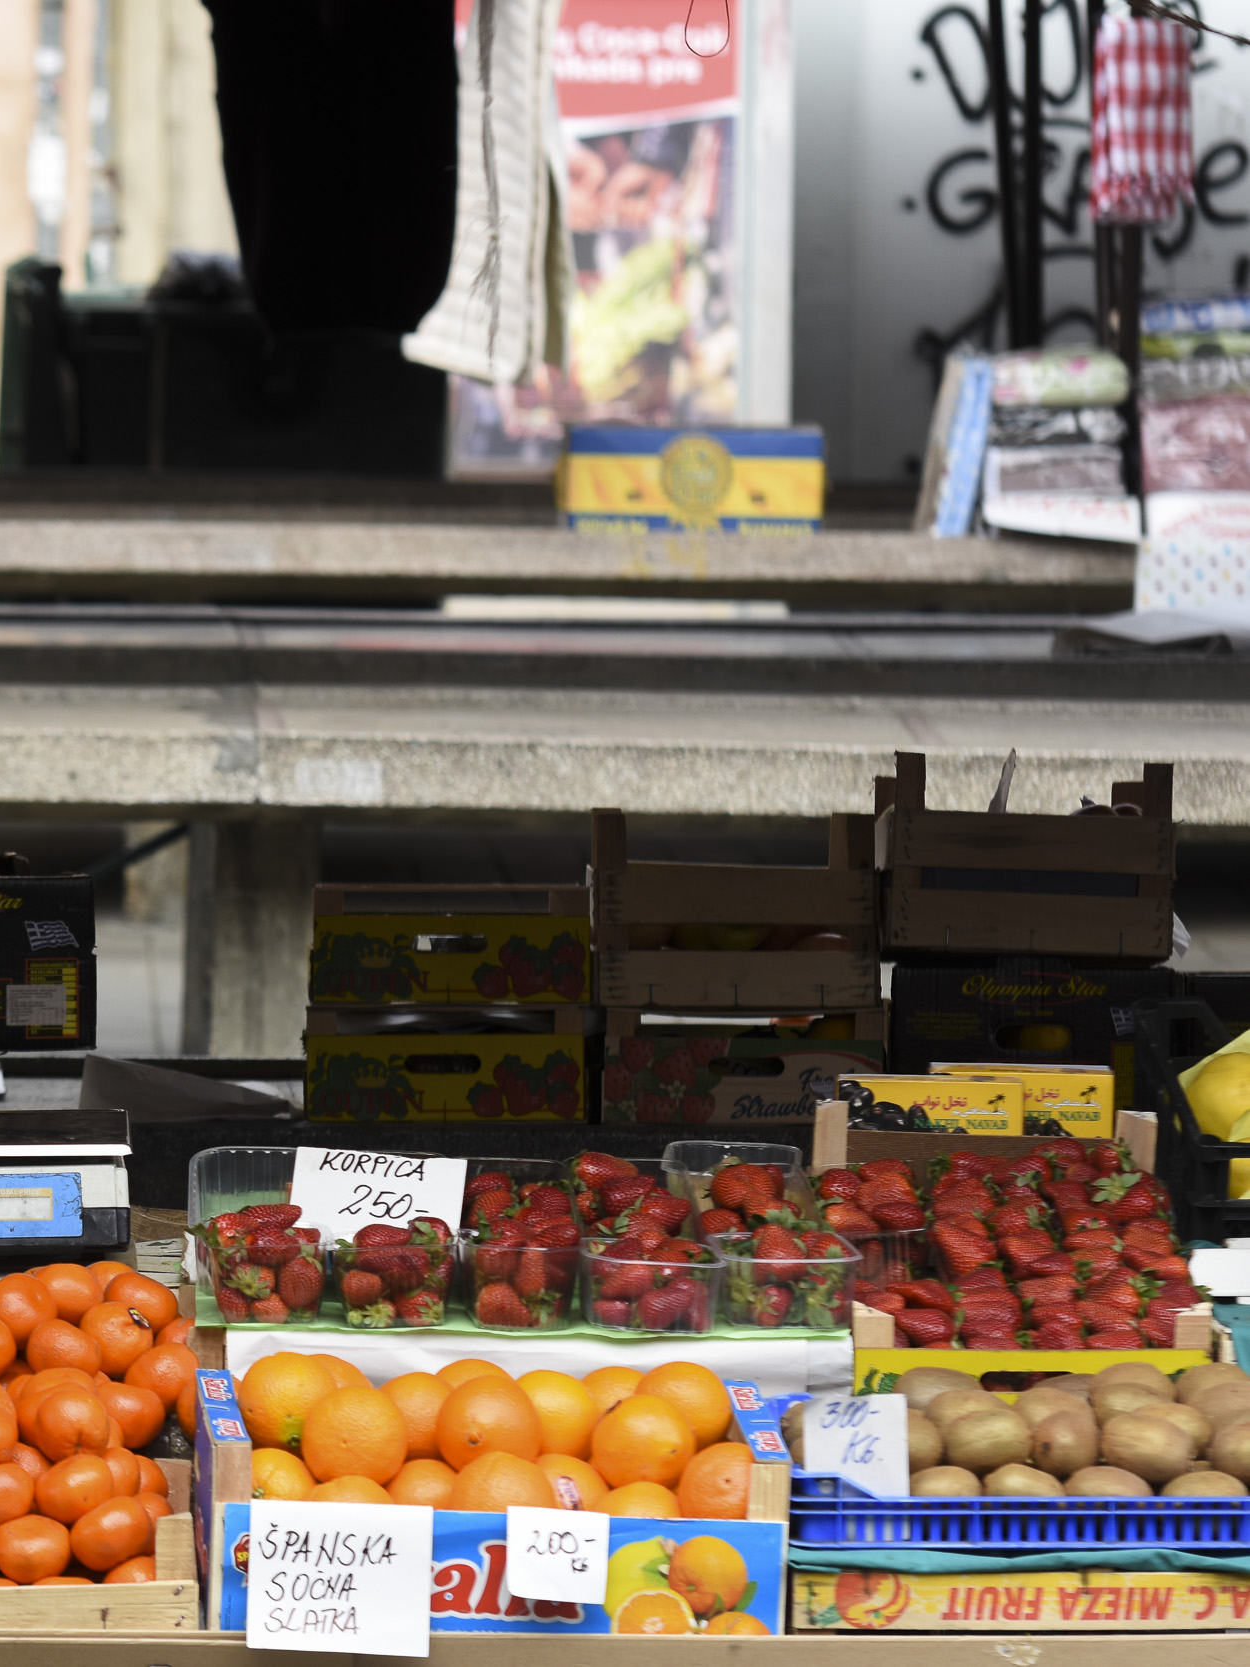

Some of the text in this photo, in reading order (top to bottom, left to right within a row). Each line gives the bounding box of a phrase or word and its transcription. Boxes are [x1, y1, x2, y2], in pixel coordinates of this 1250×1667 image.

[323, 971, 430, 997] QUEEN
[961, 975, 1108, 1002] Olympia Star
[319, 1090, 424, 1117] QUEEN
[730, 1094, 817, 1120] Strawbe
[318, 1150, 426, 1182] KORPICA
[258, 1522, 399, 1567] ŠPANSKA
[941, 1585, 1043, 1621] FRUIT
[1058, 1585, 1174, 1621] MIEZA
[264, 1606, 360, 1635] SLATKA
